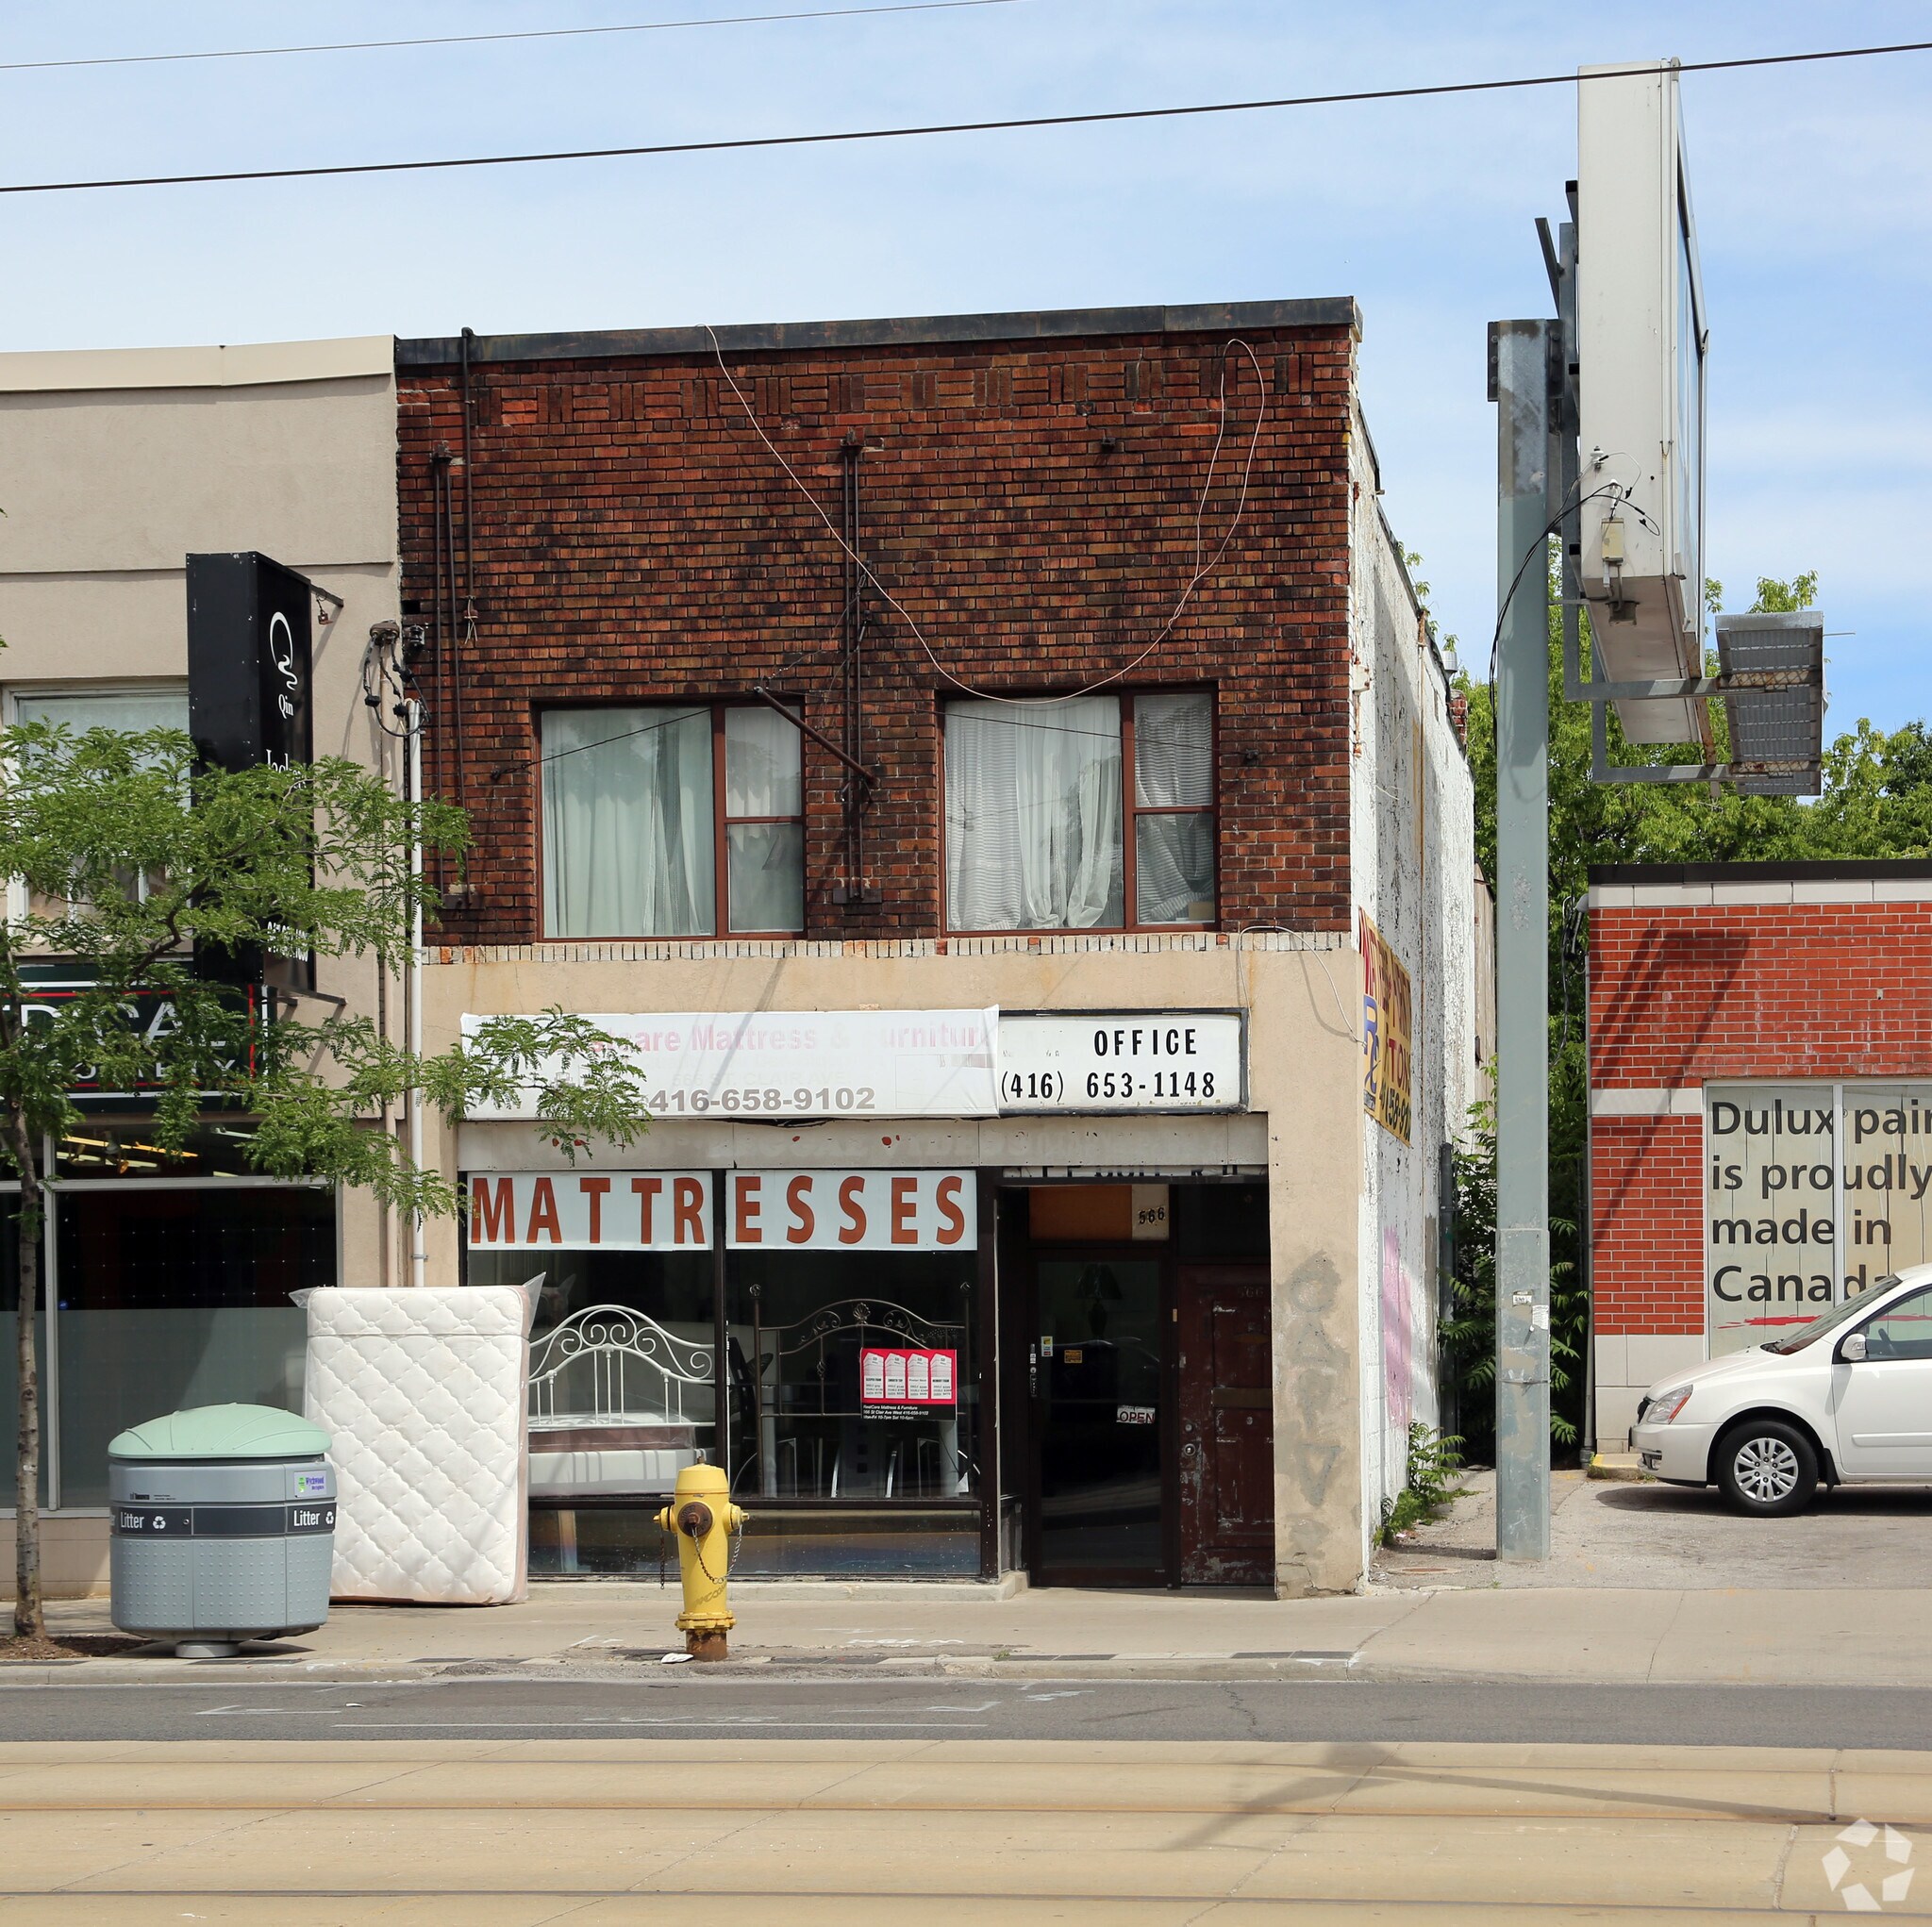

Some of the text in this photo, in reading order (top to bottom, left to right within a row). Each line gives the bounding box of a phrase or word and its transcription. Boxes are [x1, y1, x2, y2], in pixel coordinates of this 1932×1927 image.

[691, 1022, 819, 1052] Mattress
[1093, 1028, 1197, 1057] OFFICE
[648, 1087, 875, 1113] 416-658-9102
[1000, 1071, 1216, 1103] (416) 653-1148
[1711, 1098, 1834, 1136] Dulux
[1712, 1154, 1932, 1200] is proudly
[472, 1174, 965, 1245] MATTRESSES
[1138, 1205, 1166, 1226] 566
[1712, 1208, 1891, 1245] made in
[1713, 1264, 1890, 1303] Canad
[1119, 1410, 1156, 1423] OPEN
[120, 1511, 145, 1529] Litter
[293, 1509, 321, 1527] Litter
